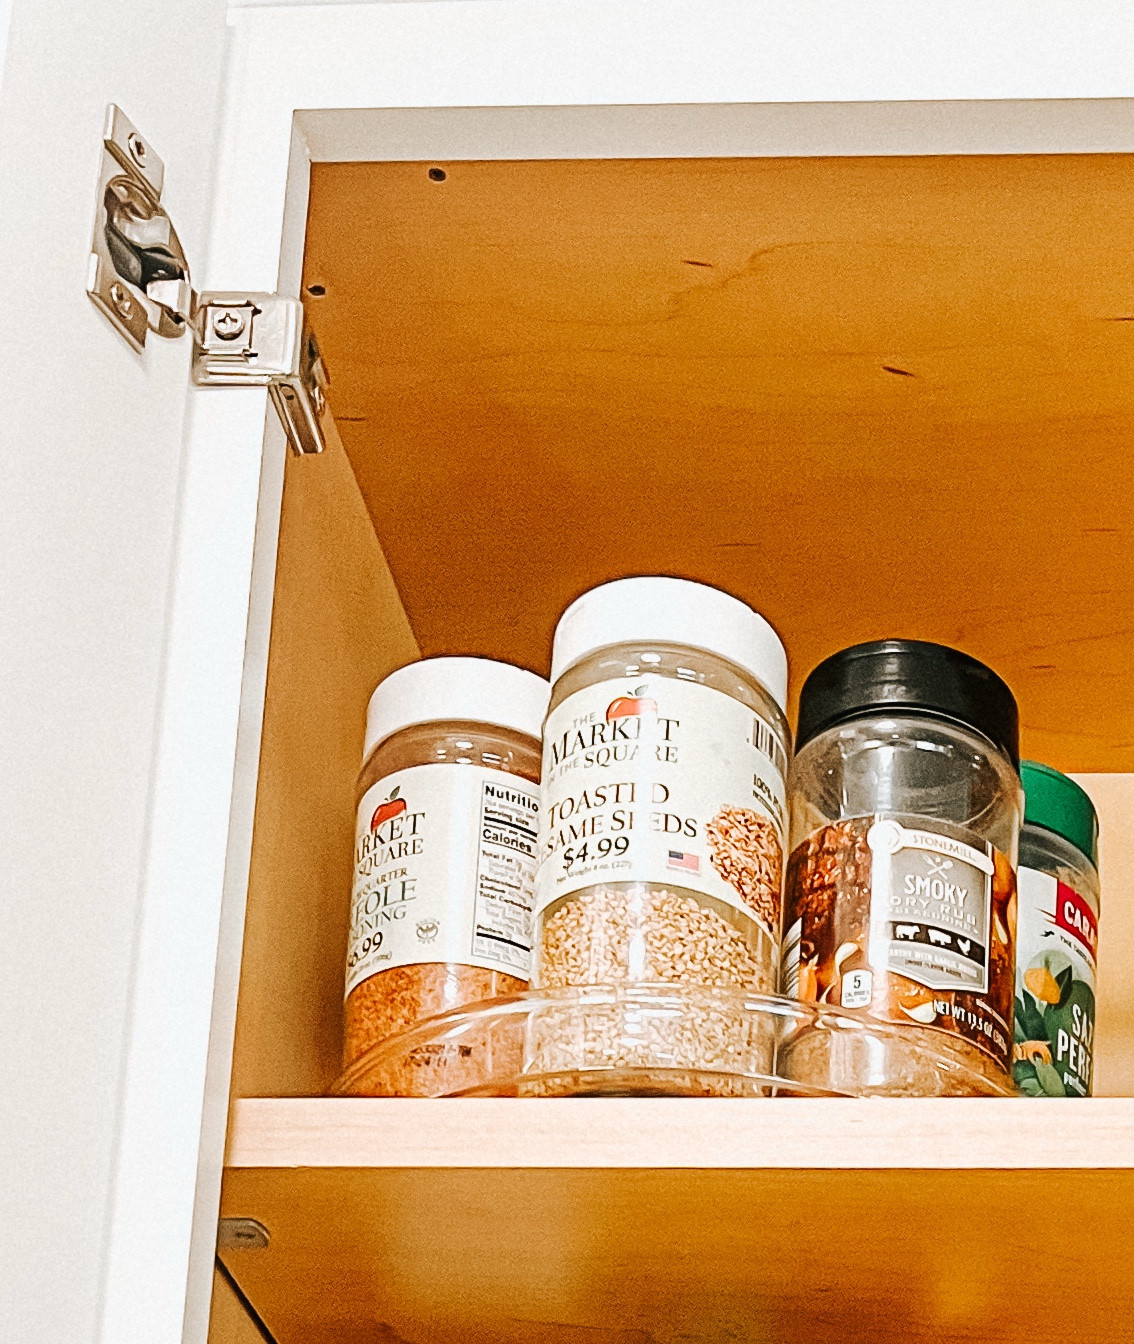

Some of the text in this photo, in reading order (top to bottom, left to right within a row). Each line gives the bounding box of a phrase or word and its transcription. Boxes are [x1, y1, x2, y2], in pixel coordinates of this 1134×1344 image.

[573, 712, 597, 728] THE
[485, 785, 539, 812] Nutritio
[483, 828, 532, 853] Calories
[912, 834, 976, 862] STONEMILL
[562, 836, 630, 875] $4.99
[890, 895, 930, 909] DRY
[904, 874, 969, 908] SMOKY
[852, 974, 862, 990] 5
[933, 999, 966, 1022] NET WT
